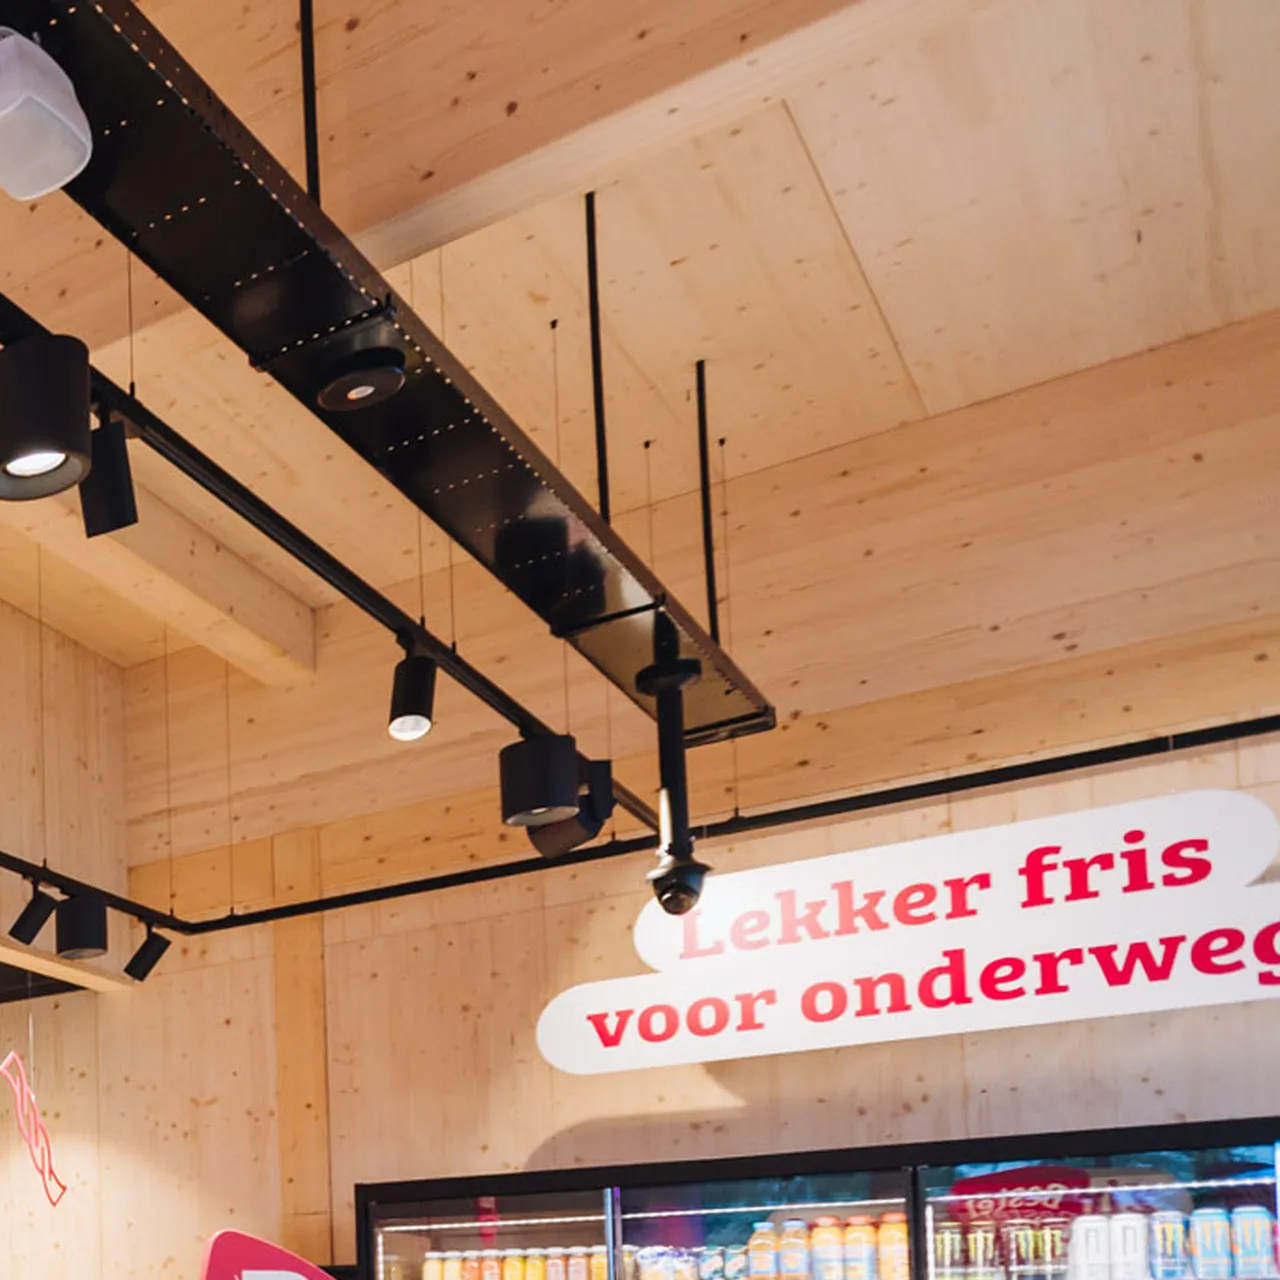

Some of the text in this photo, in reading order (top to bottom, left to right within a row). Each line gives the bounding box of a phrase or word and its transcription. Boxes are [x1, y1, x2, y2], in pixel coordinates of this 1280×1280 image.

[678, 828, 1214, 961] Lekker fris
[587, 987, 779, 1050] voor
